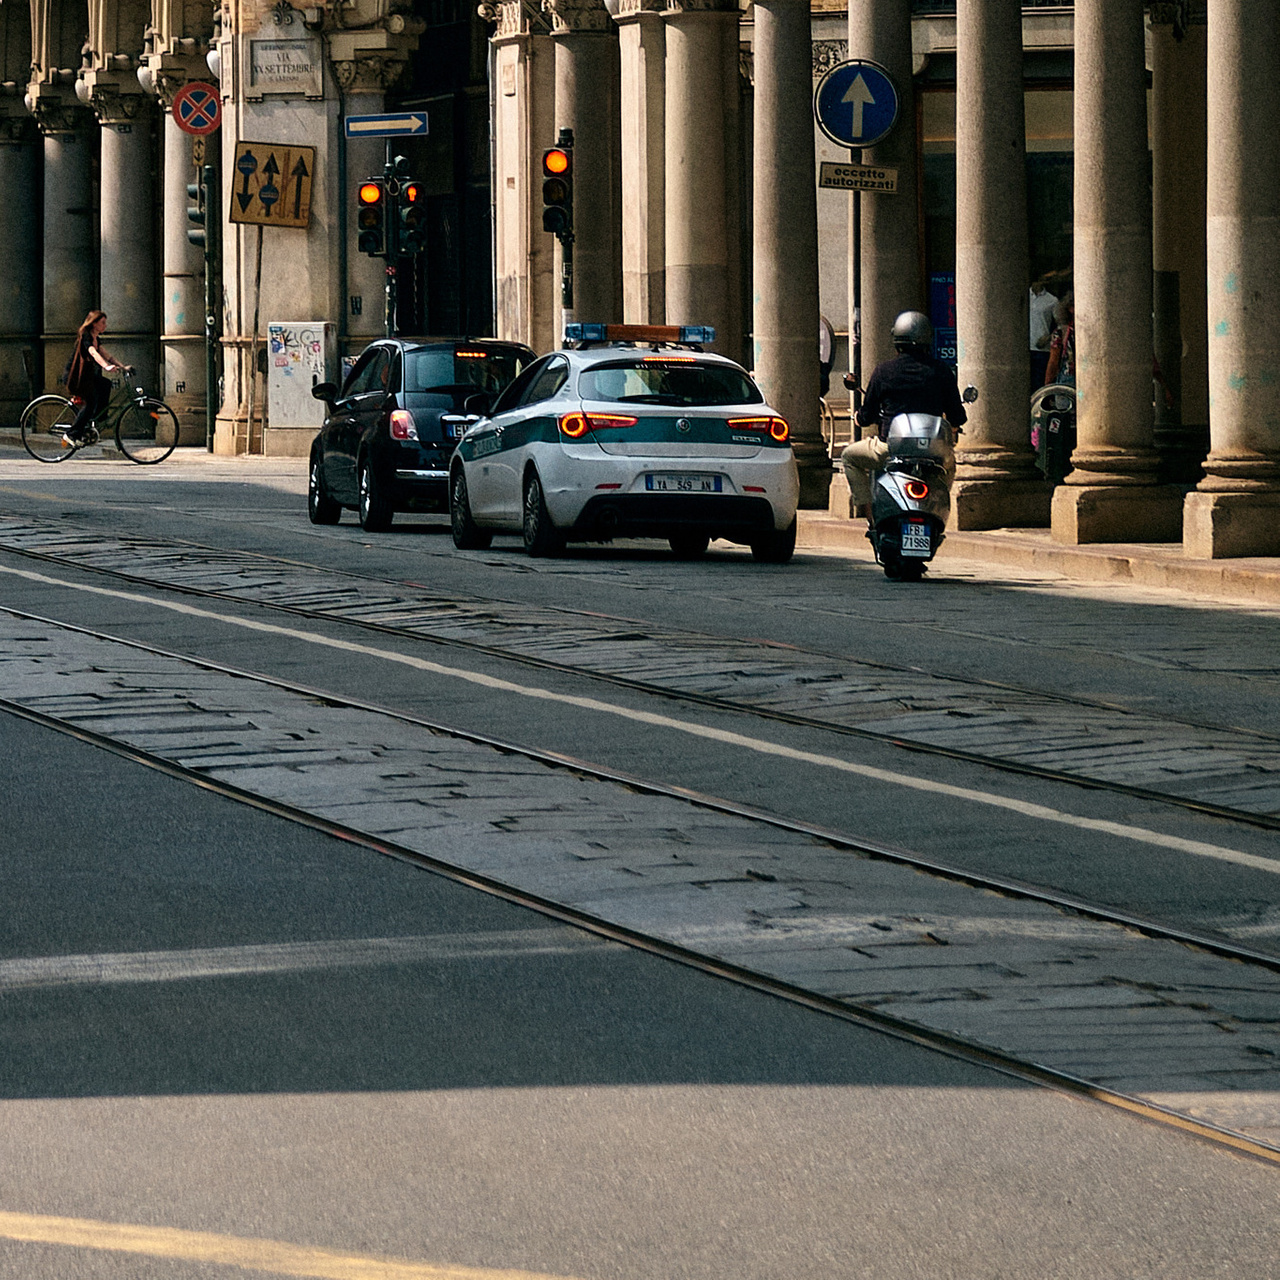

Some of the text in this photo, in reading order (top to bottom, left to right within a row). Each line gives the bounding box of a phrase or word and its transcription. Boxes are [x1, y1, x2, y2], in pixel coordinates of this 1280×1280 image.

[277, 52, 291, 62] VIA
[834, 168, 886, 179] eccetto
[824, 177, 894, 189] autorizzati
